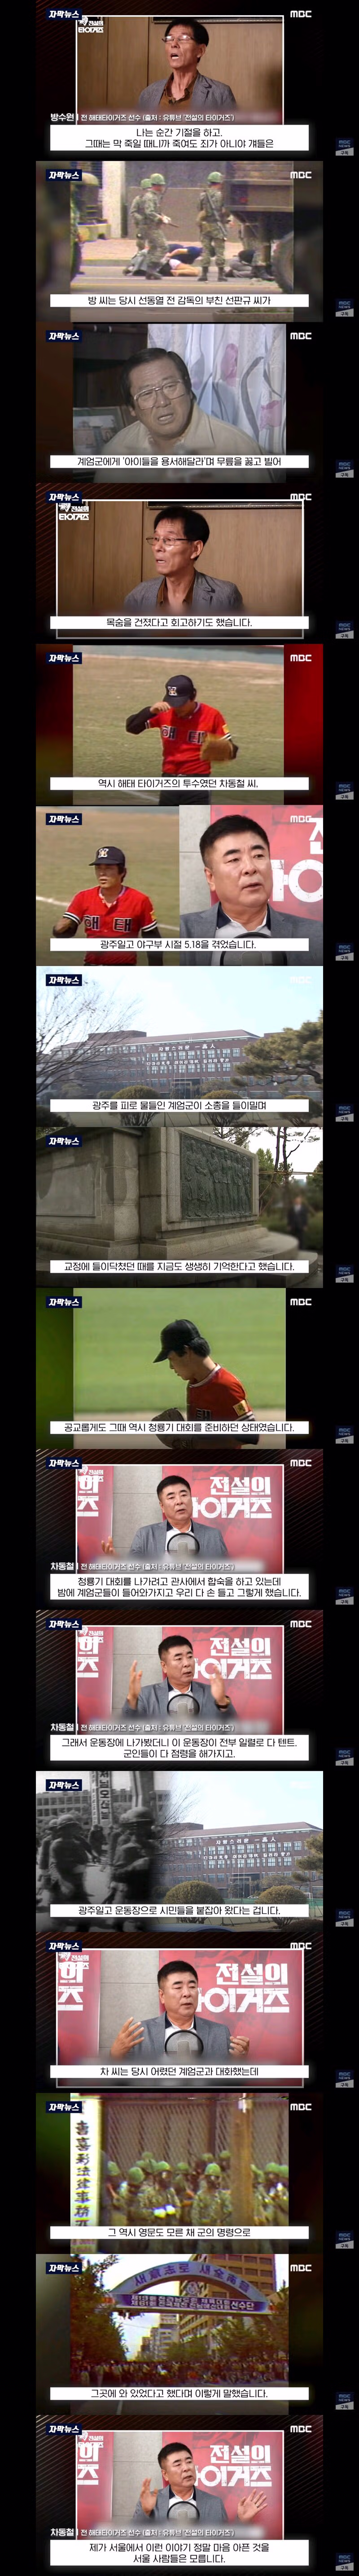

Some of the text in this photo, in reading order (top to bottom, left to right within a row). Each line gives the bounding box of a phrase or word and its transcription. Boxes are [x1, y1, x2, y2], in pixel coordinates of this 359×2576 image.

[210, 1477, 271, 1495] 전설의
[210, 1638, 271, 1656] 전설의
[215, 1963, 288, 1985] 전설의
[231, 2301, 254, 2310] 선수단
[210, 2445, 271, 2464] 전설의
